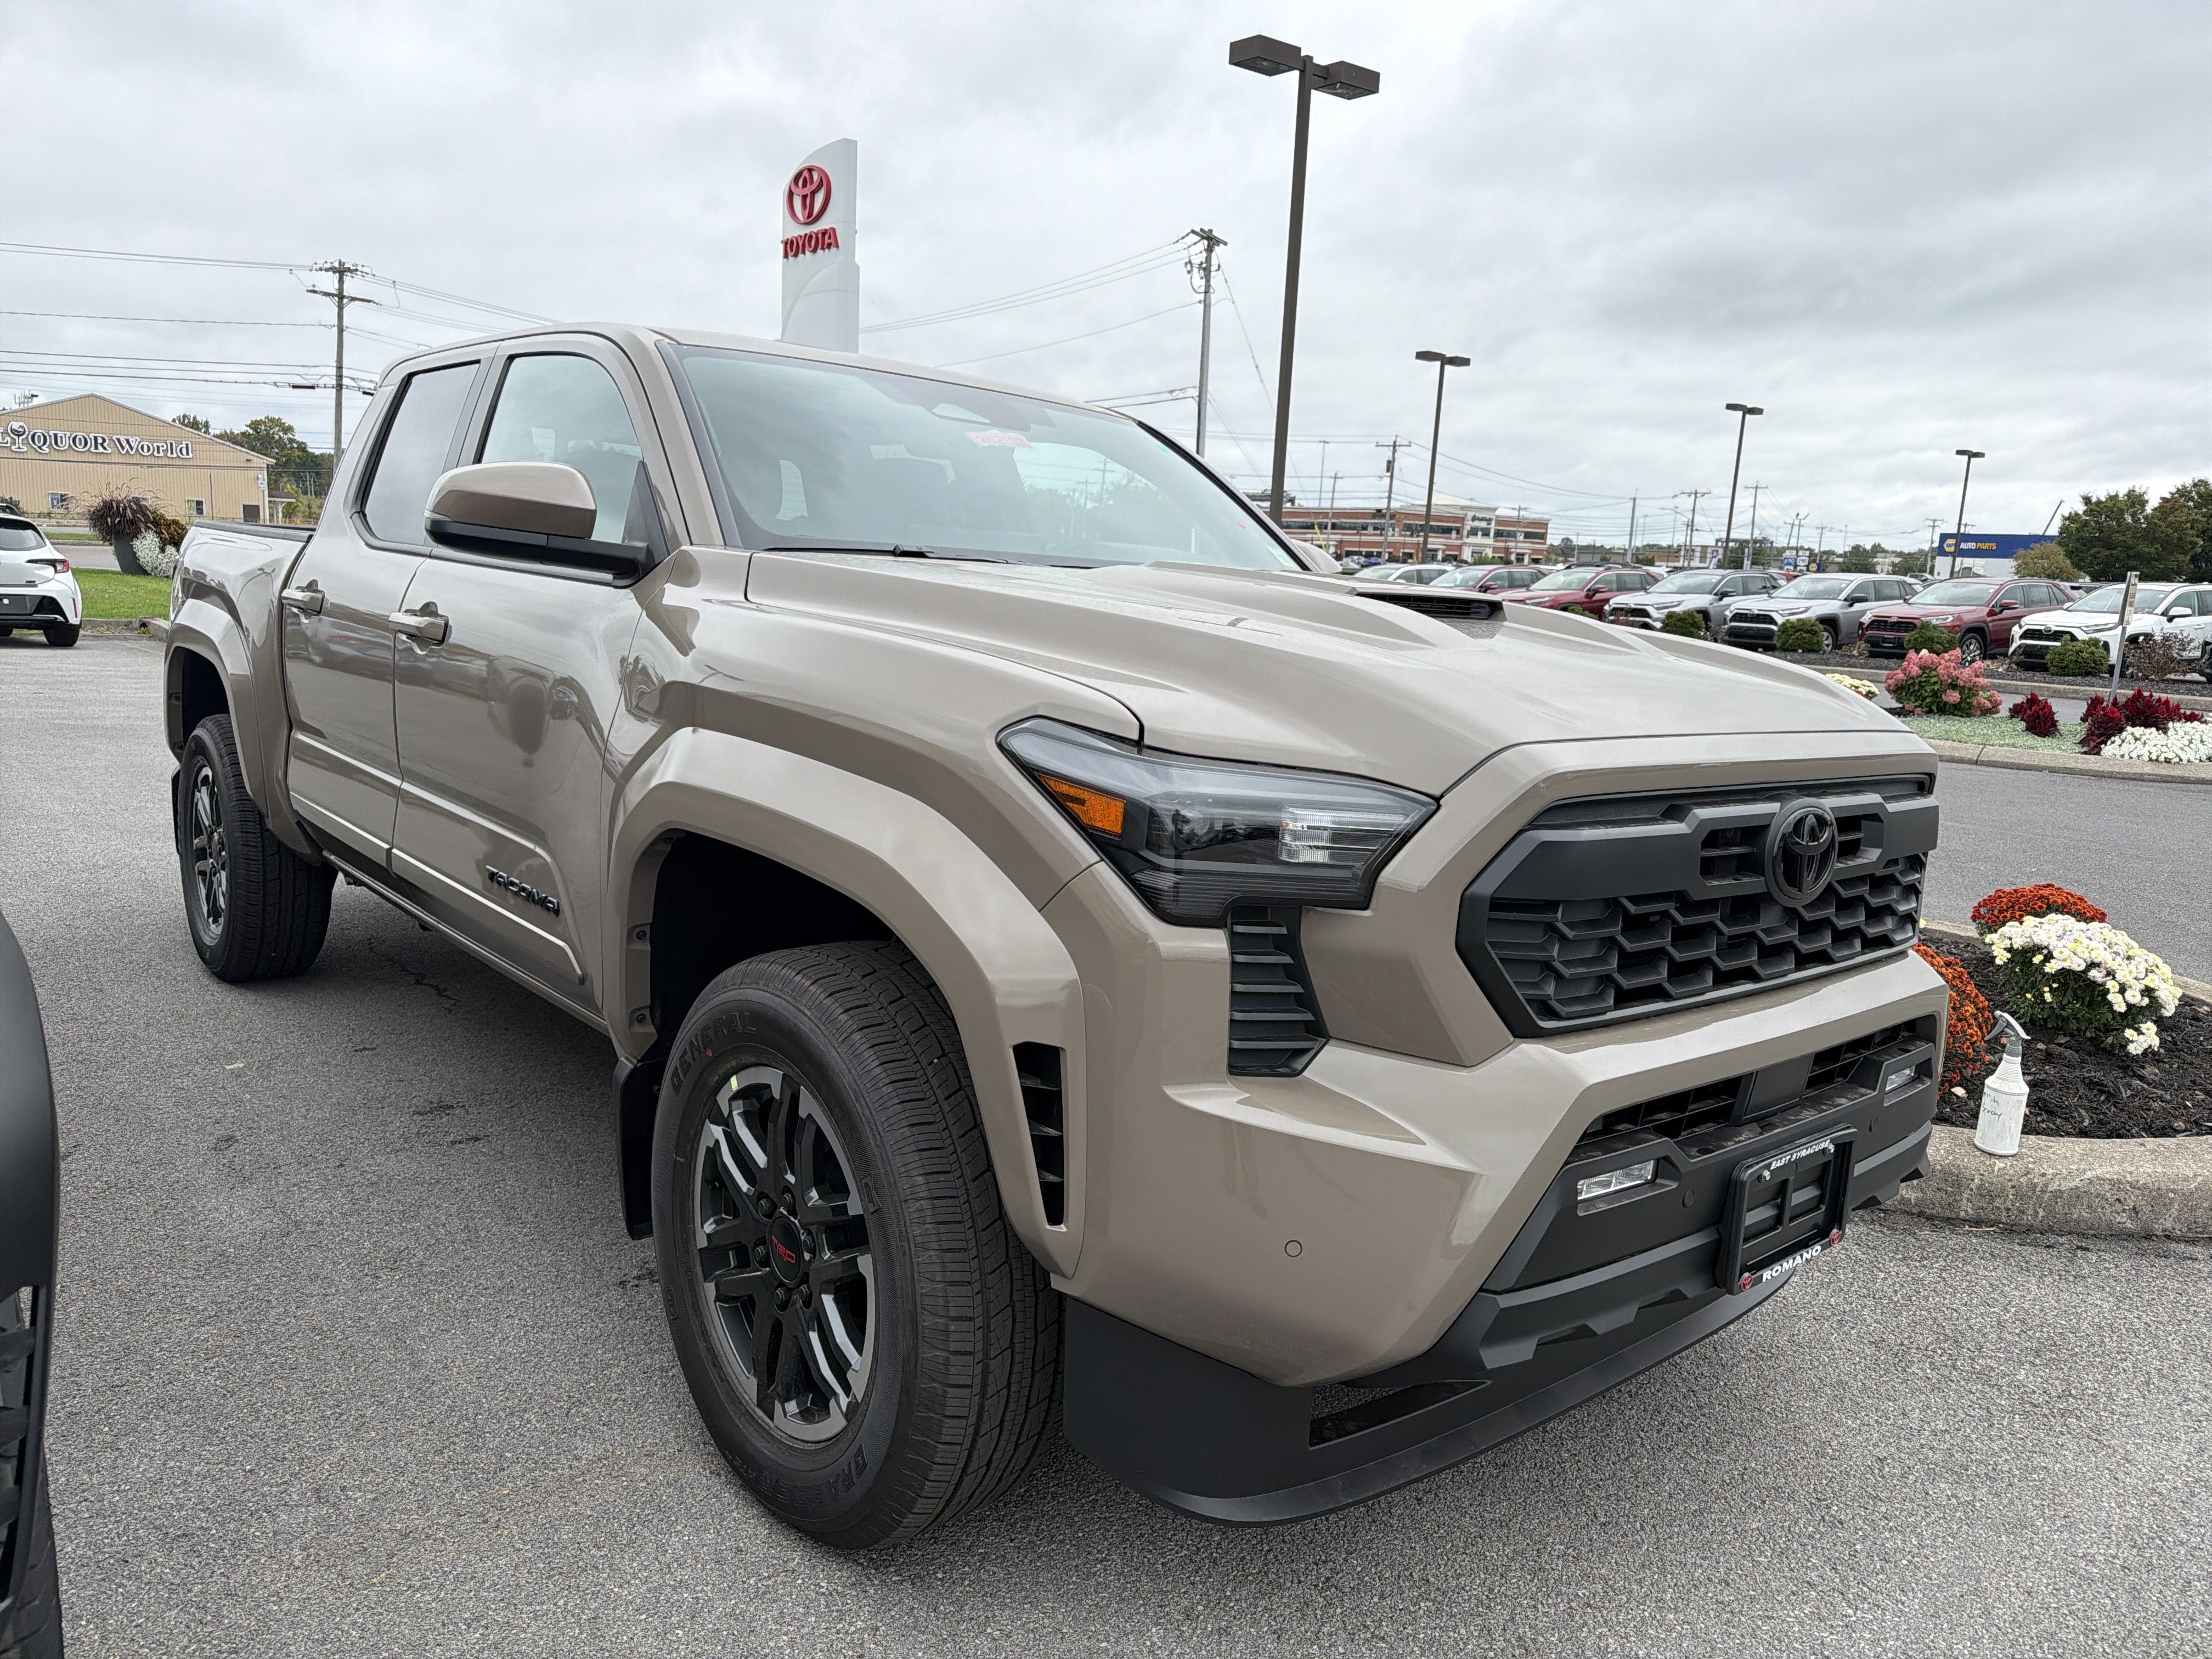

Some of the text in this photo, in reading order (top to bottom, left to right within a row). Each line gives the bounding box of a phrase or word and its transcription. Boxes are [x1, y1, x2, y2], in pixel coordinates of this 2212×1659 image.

[781, 227, 839, 259] TOYOTA
[112, 436, 193, 459] World
[486, 865, 560, 917] TACOMA
[670, 1013, 757, 1096] GENERAL
[1770, 1139, 1831, 1170] EAST SYRACUSE
[771, 1234, 796, 1263] TRD
[1762, 1245, 1821, 1283] ROMANO
